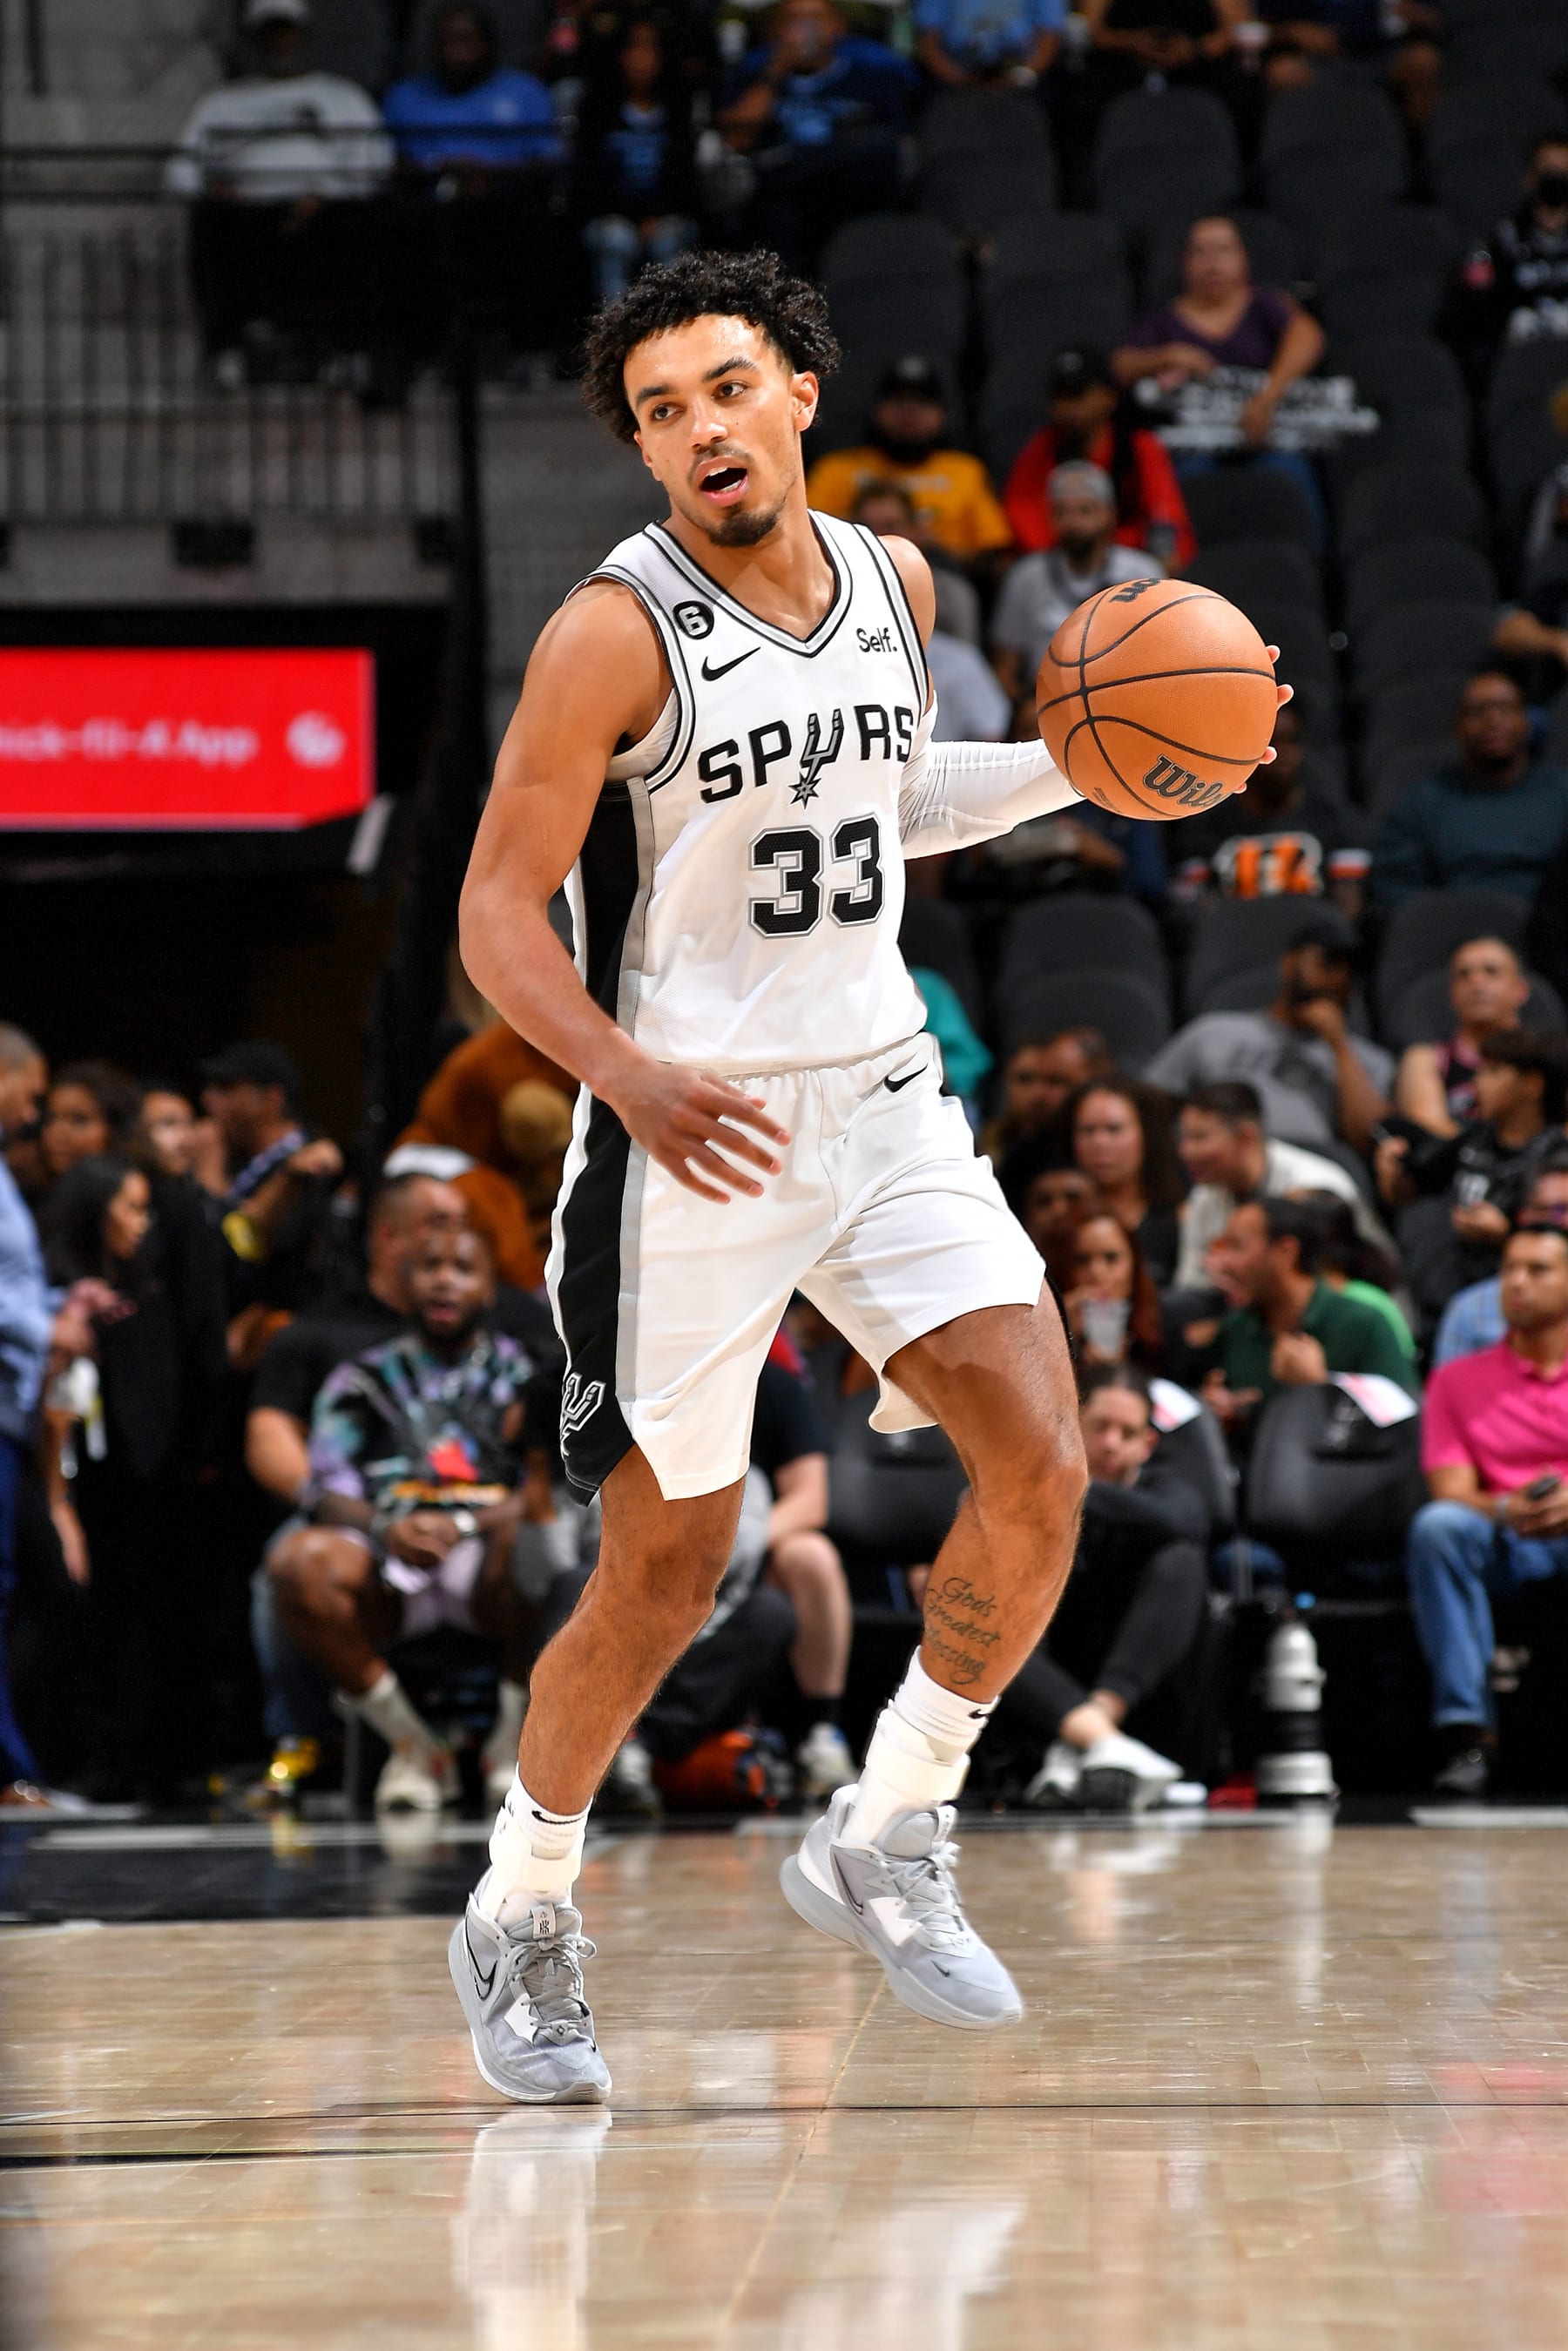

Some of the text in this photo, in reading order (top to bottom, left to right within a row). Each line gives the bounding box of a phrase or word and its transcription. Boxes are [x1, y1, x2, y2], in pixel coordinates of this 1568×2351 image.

[678, 605, 709, 637] 6
[855, 626, 898, 653] Self.
[697, 704, 914, 810] SPURS
[748, 812, 885, 940] 33
